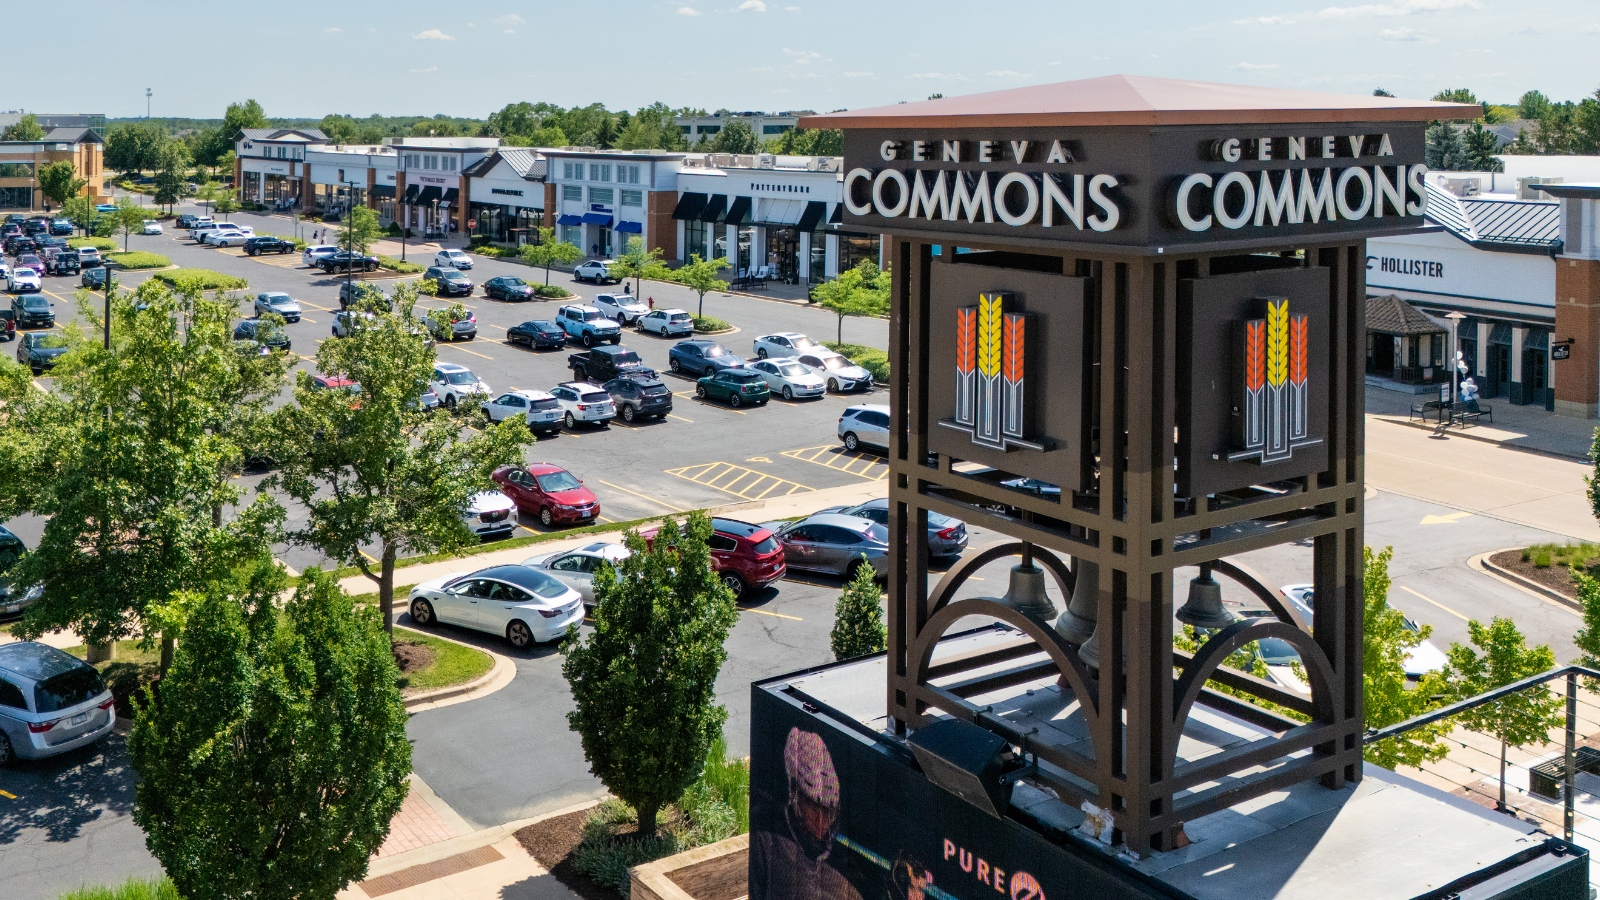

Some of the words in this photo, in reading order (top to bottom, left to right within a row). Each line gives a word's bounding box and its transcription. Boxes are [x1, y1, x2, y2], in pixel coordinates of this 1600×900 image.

[880, 139, 1066, 164] GENEVA
[1221, 133, 1395, 163] GENEVA
[843, 167, 1120, 233] COMMONS
[1176, 163, 1430, 233] COMMONS
[1380, 256, 1444, 279] HOLLISTER
[943, 837, 1006, 894] PURE
